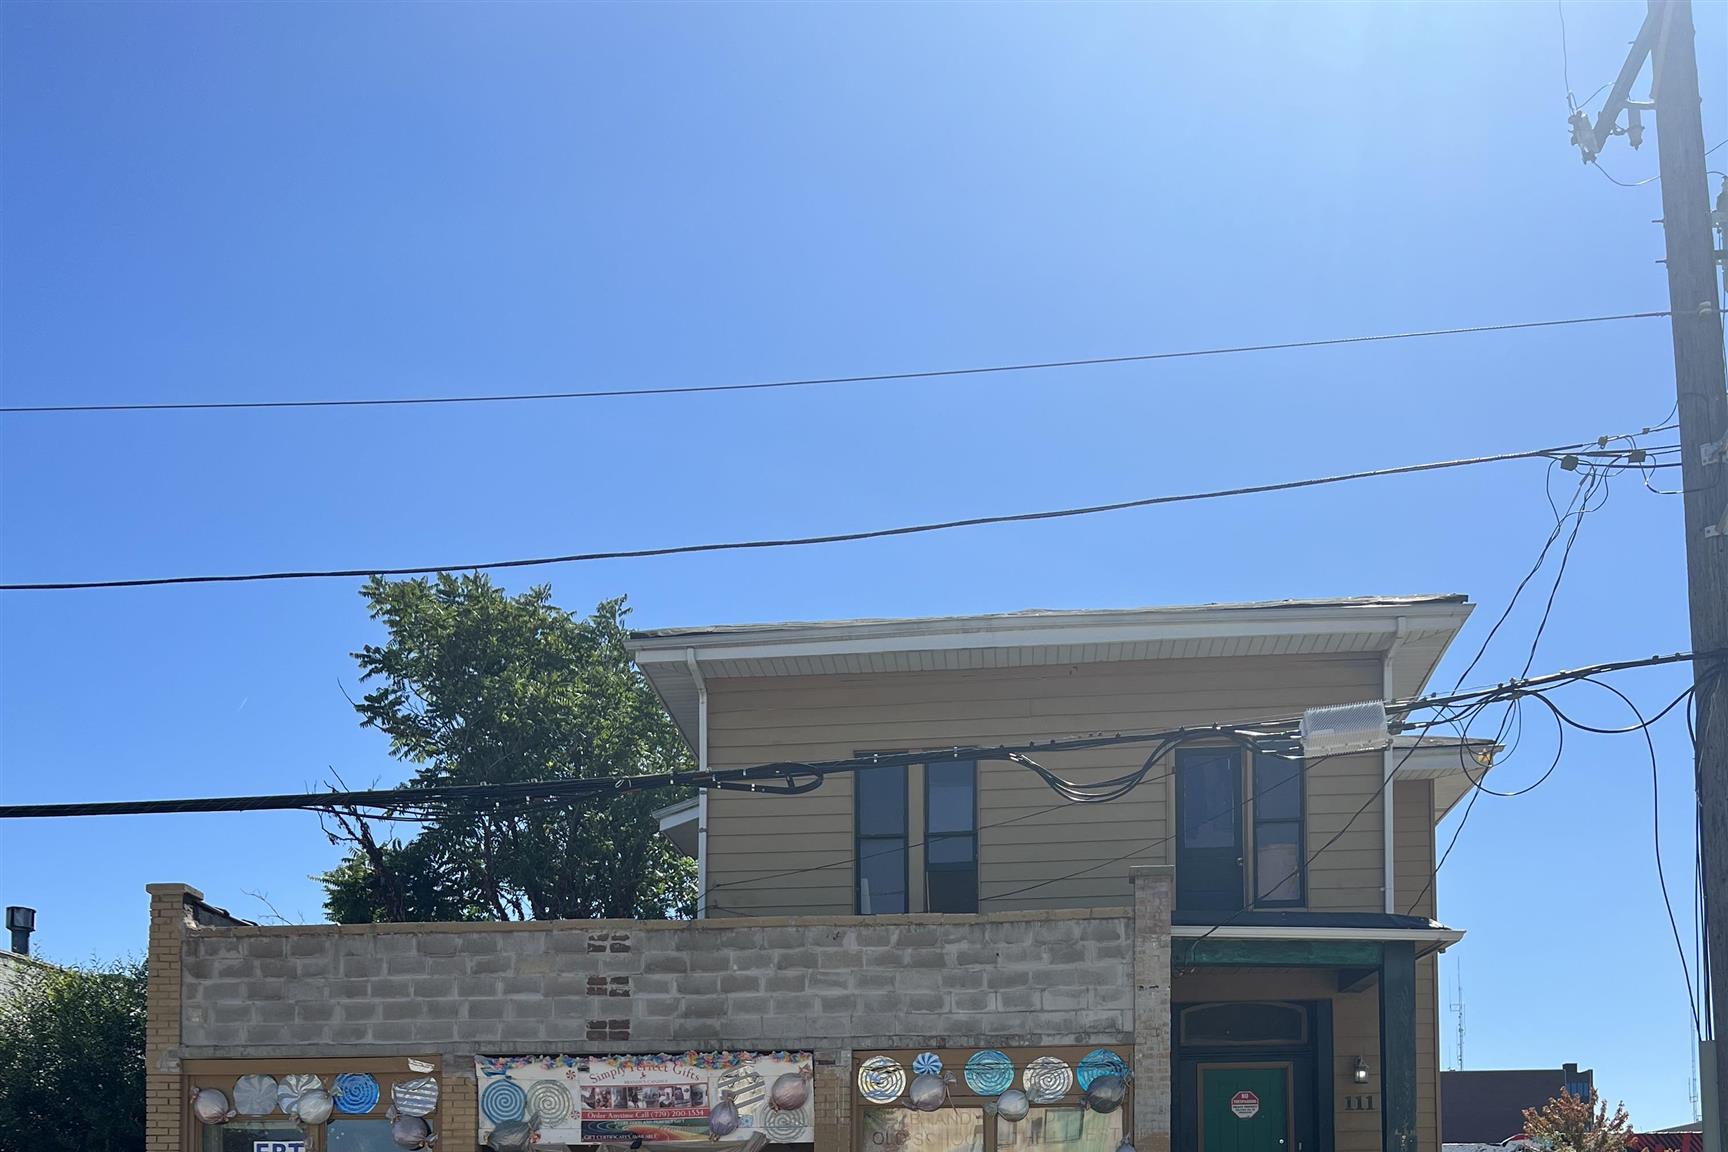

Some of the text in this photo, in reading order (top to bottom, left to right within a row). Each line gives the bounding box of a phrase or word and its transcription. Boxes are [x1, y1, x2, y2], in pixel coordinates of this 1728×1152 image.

[589, 1066, 625, 1084] Simply
[672, 1061, 700, 1081] Gifts
[1344, 1095, 1375, 1111] 111
